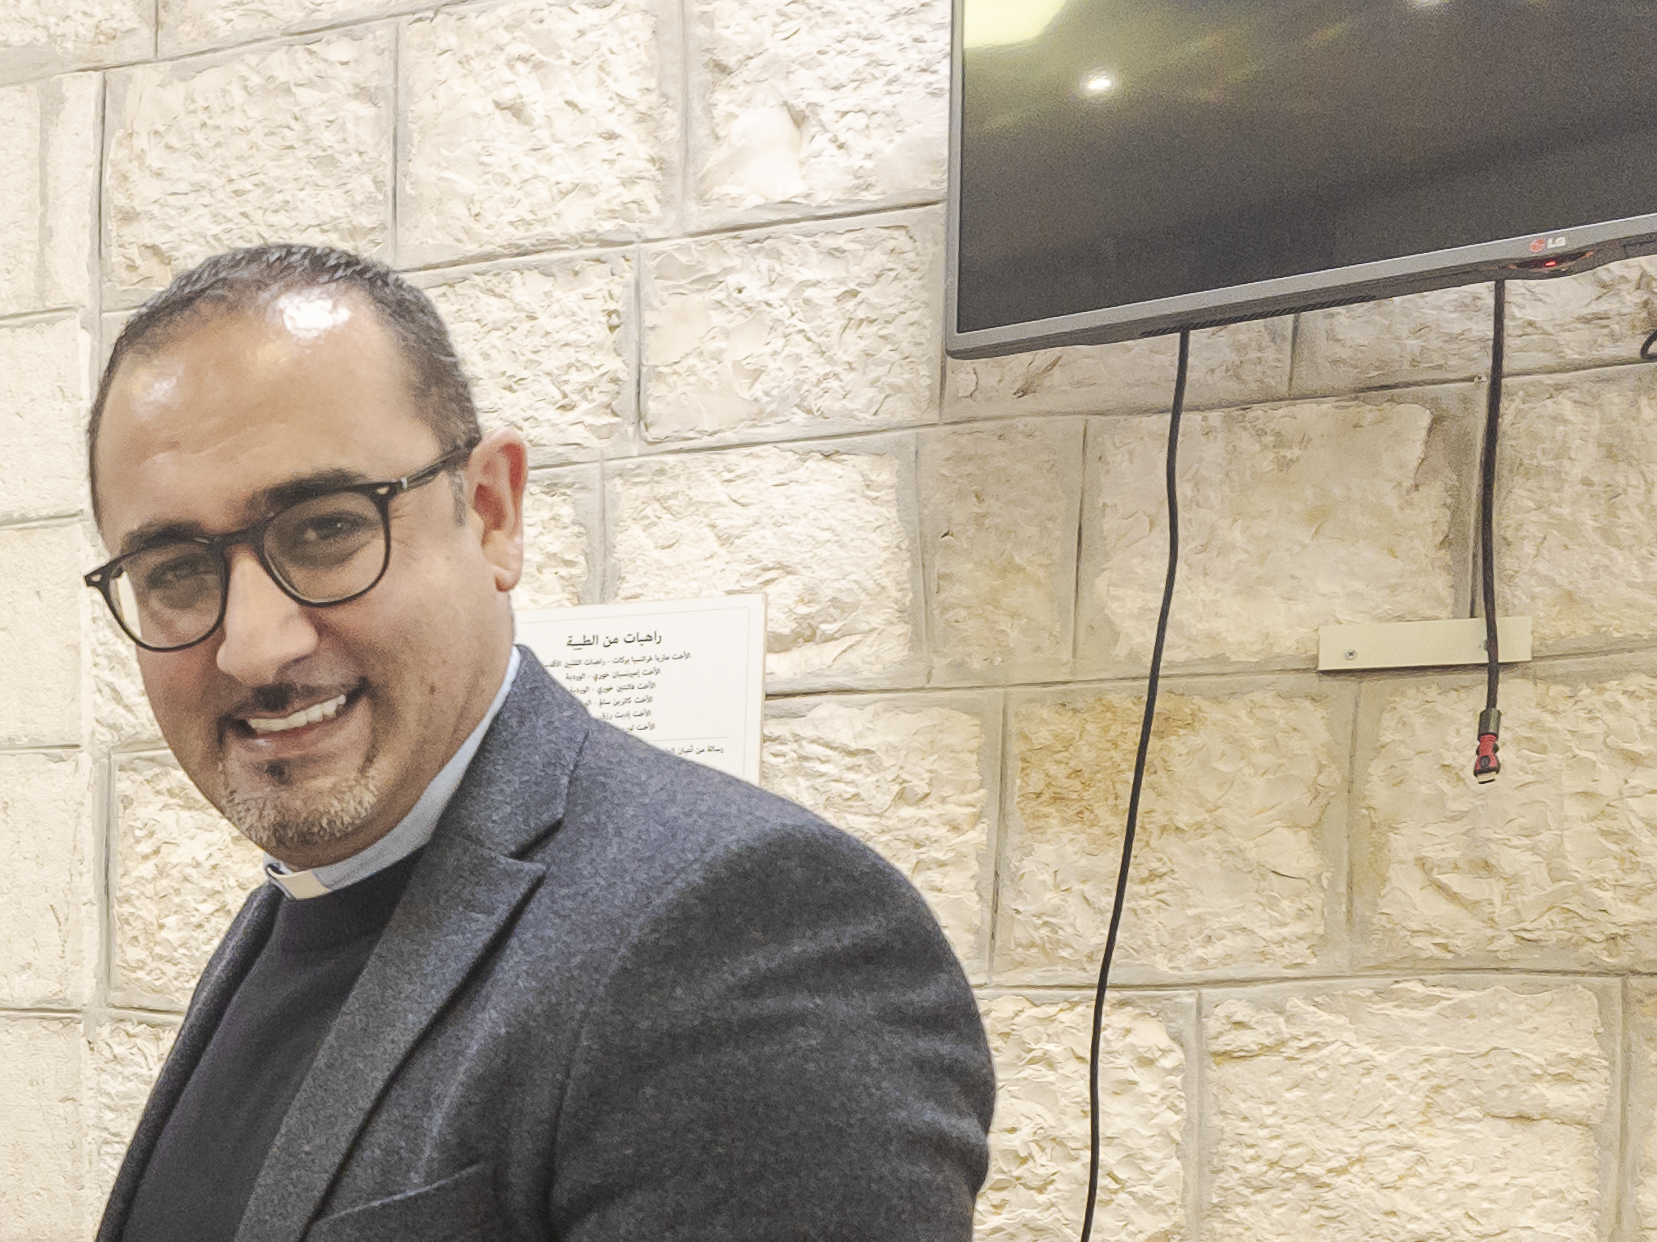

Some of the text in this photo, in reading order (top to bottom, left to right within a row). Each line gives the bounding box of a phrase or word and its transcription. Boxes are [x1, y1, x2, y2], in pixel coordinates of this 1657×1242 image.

[1547, 236, 1566, 248] LG
[566, 630, 662, 651] راهبات من الطيبة
[671, 650, 691, 660] الأخت
[642, 666, 661, 676] الأخت
[637, 680, 656, 690] الأخت
[634, 695, 654, 704] الأخت
[632, 708, 652, 717] الأخت
[636, 722, 656, 731] الأخت
